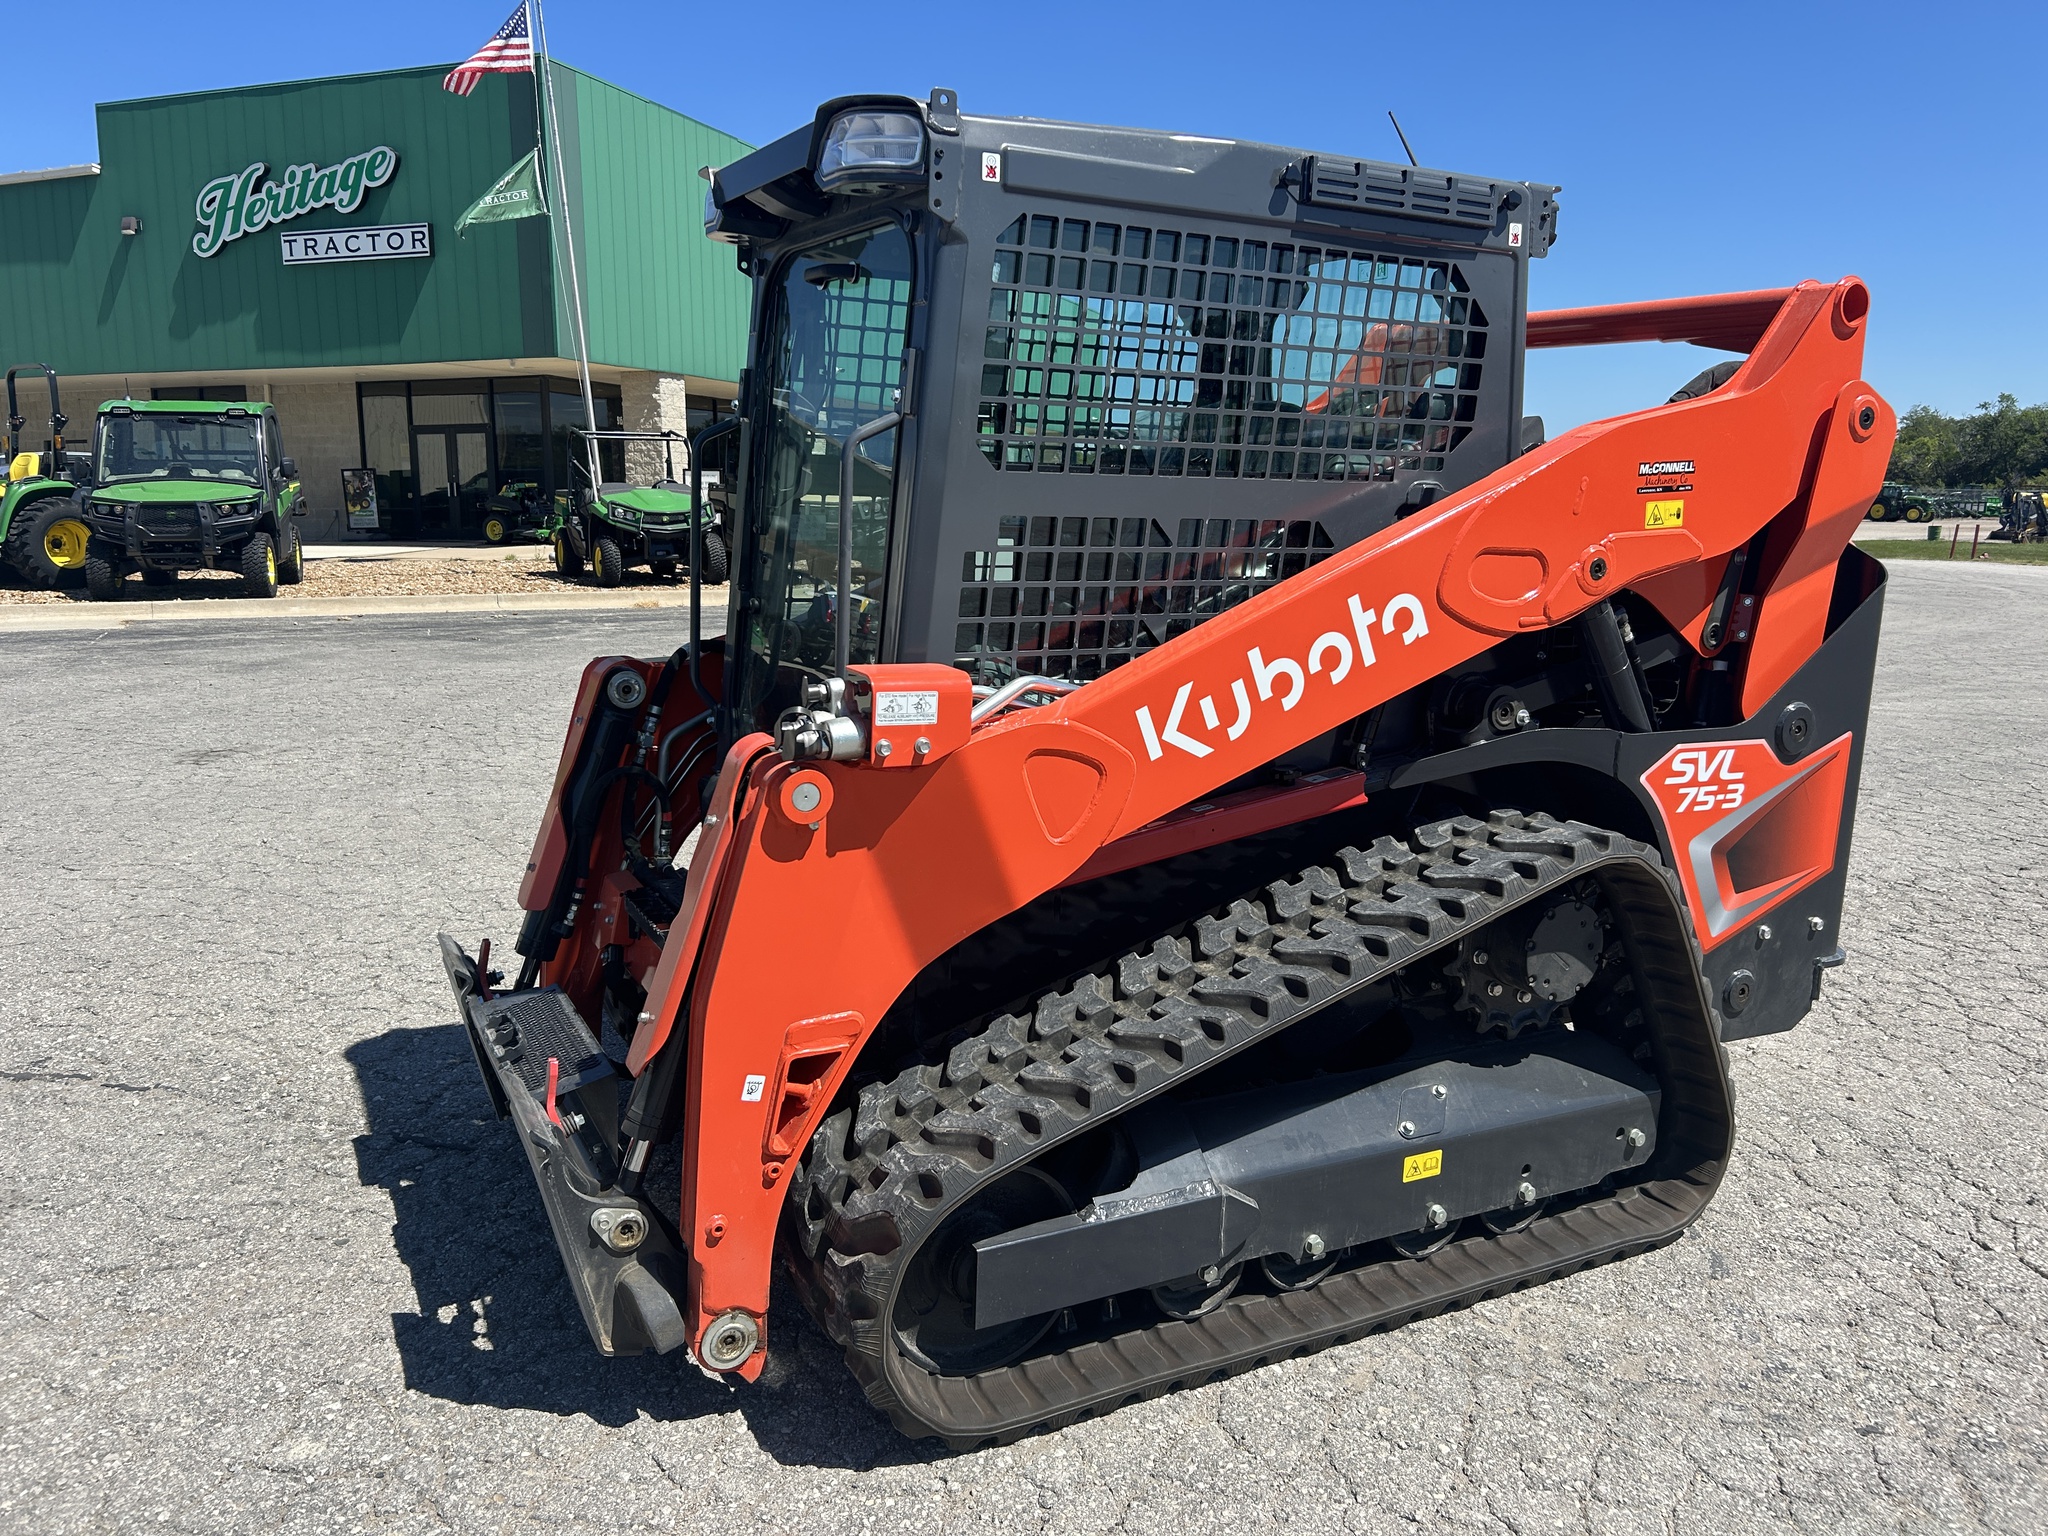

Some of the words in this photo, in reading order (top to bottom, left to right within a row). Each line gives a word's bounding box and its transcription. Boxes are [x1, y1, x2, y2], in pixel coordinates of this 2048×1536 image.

[194, 147, 396, 256] Heritage
[283, 230, 428, 257] TRACTOR
[1135, 593, 1429, 761] Kubota
[1664, 749, 1744, 785] SVL
[1675, 783, 1745, 813] 75-3
